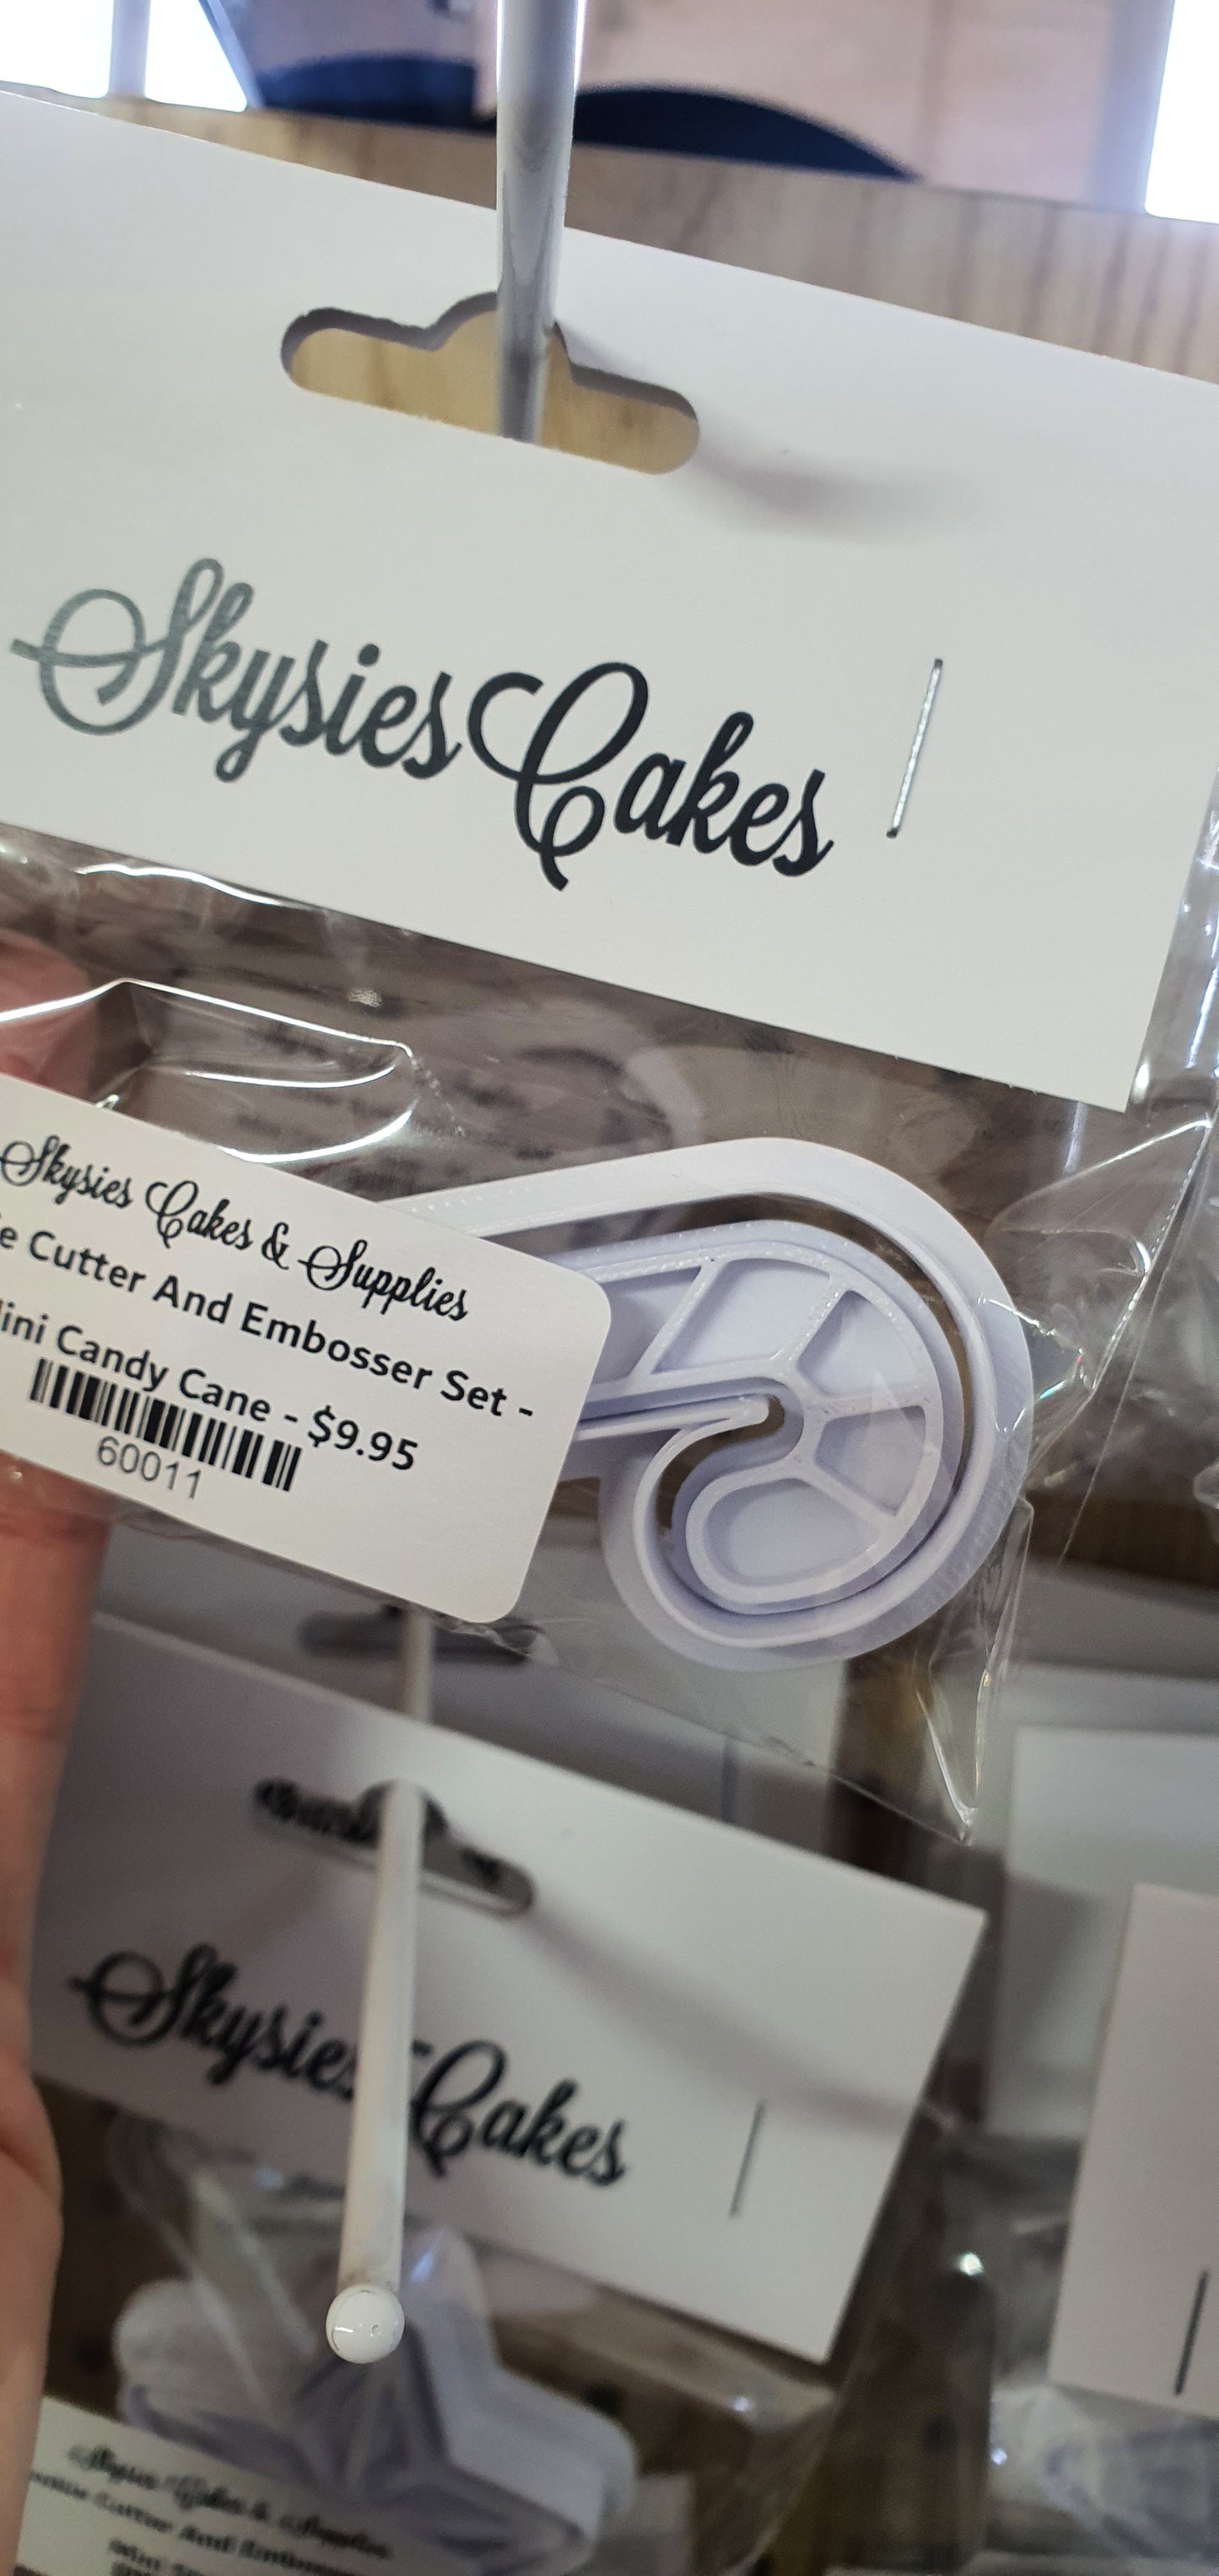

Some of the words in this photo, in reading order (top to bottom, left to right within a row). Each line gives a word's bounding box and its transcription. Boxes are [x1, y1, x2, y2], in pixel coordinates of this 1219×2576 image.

[10, 558, 462, 784] Skysies
[467, 661, 835, 892] Cakes
[0, 1134, 132, 1210] Skysies
[144, 1180, 254, 1251] Cakes
[261, 1221, 290, 1270] &
[296, 1238, 468, 1322] Supplies
[0, 1299, 48, 1345] ini
[57, 1324, 170, 1393] Candy
[179, 1367, 271, 1422] Cane
[307, 1404, 418, 1471] $9.95
[29, 1230, 147, 1293] Cutter
[152, 1275, 234, 1324] And
[240, 1301, 434, 1390] Embosser
[440, 1370, 508, 1417] Set
[97, 1436, 202, 1500] 60011
[410, 2040, 626, 2186] Cakes
